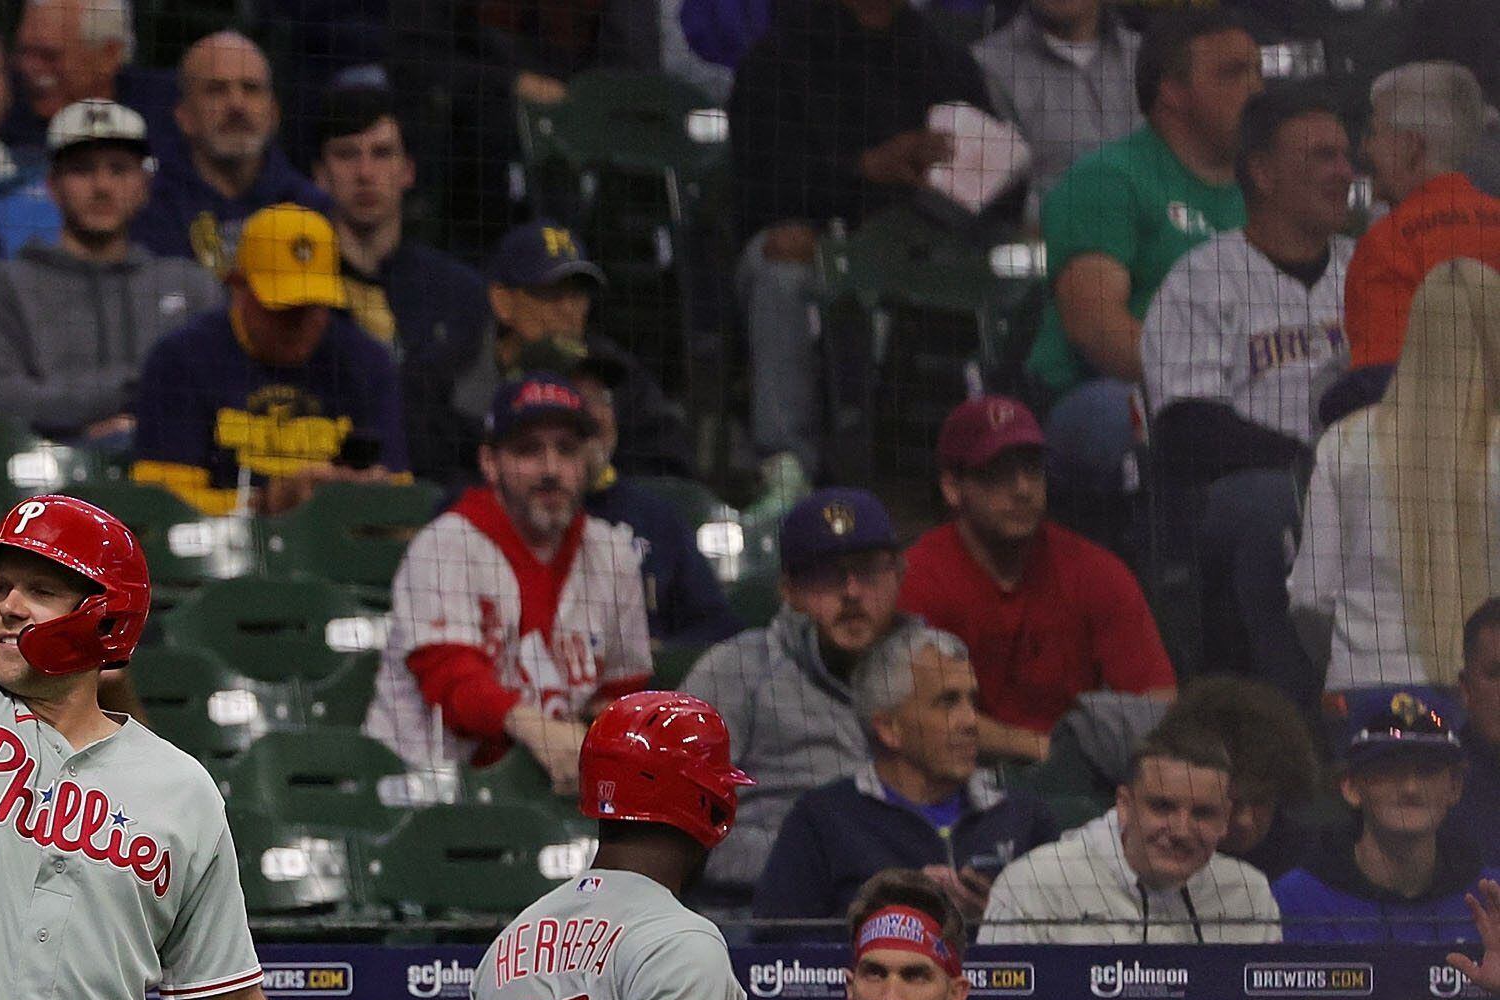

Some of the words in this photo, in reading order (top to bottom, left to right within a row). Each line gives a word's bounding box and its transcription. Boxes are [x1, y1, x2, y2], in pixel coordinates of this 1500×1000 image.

[13, 501, 47, 535] P
[597, 779, 616, 801] 37
[496, 917, 626, 990] HERRERA
[261, 969, 344, 989] WERS.COM
[407, 959, 475, 998] SCJohn
